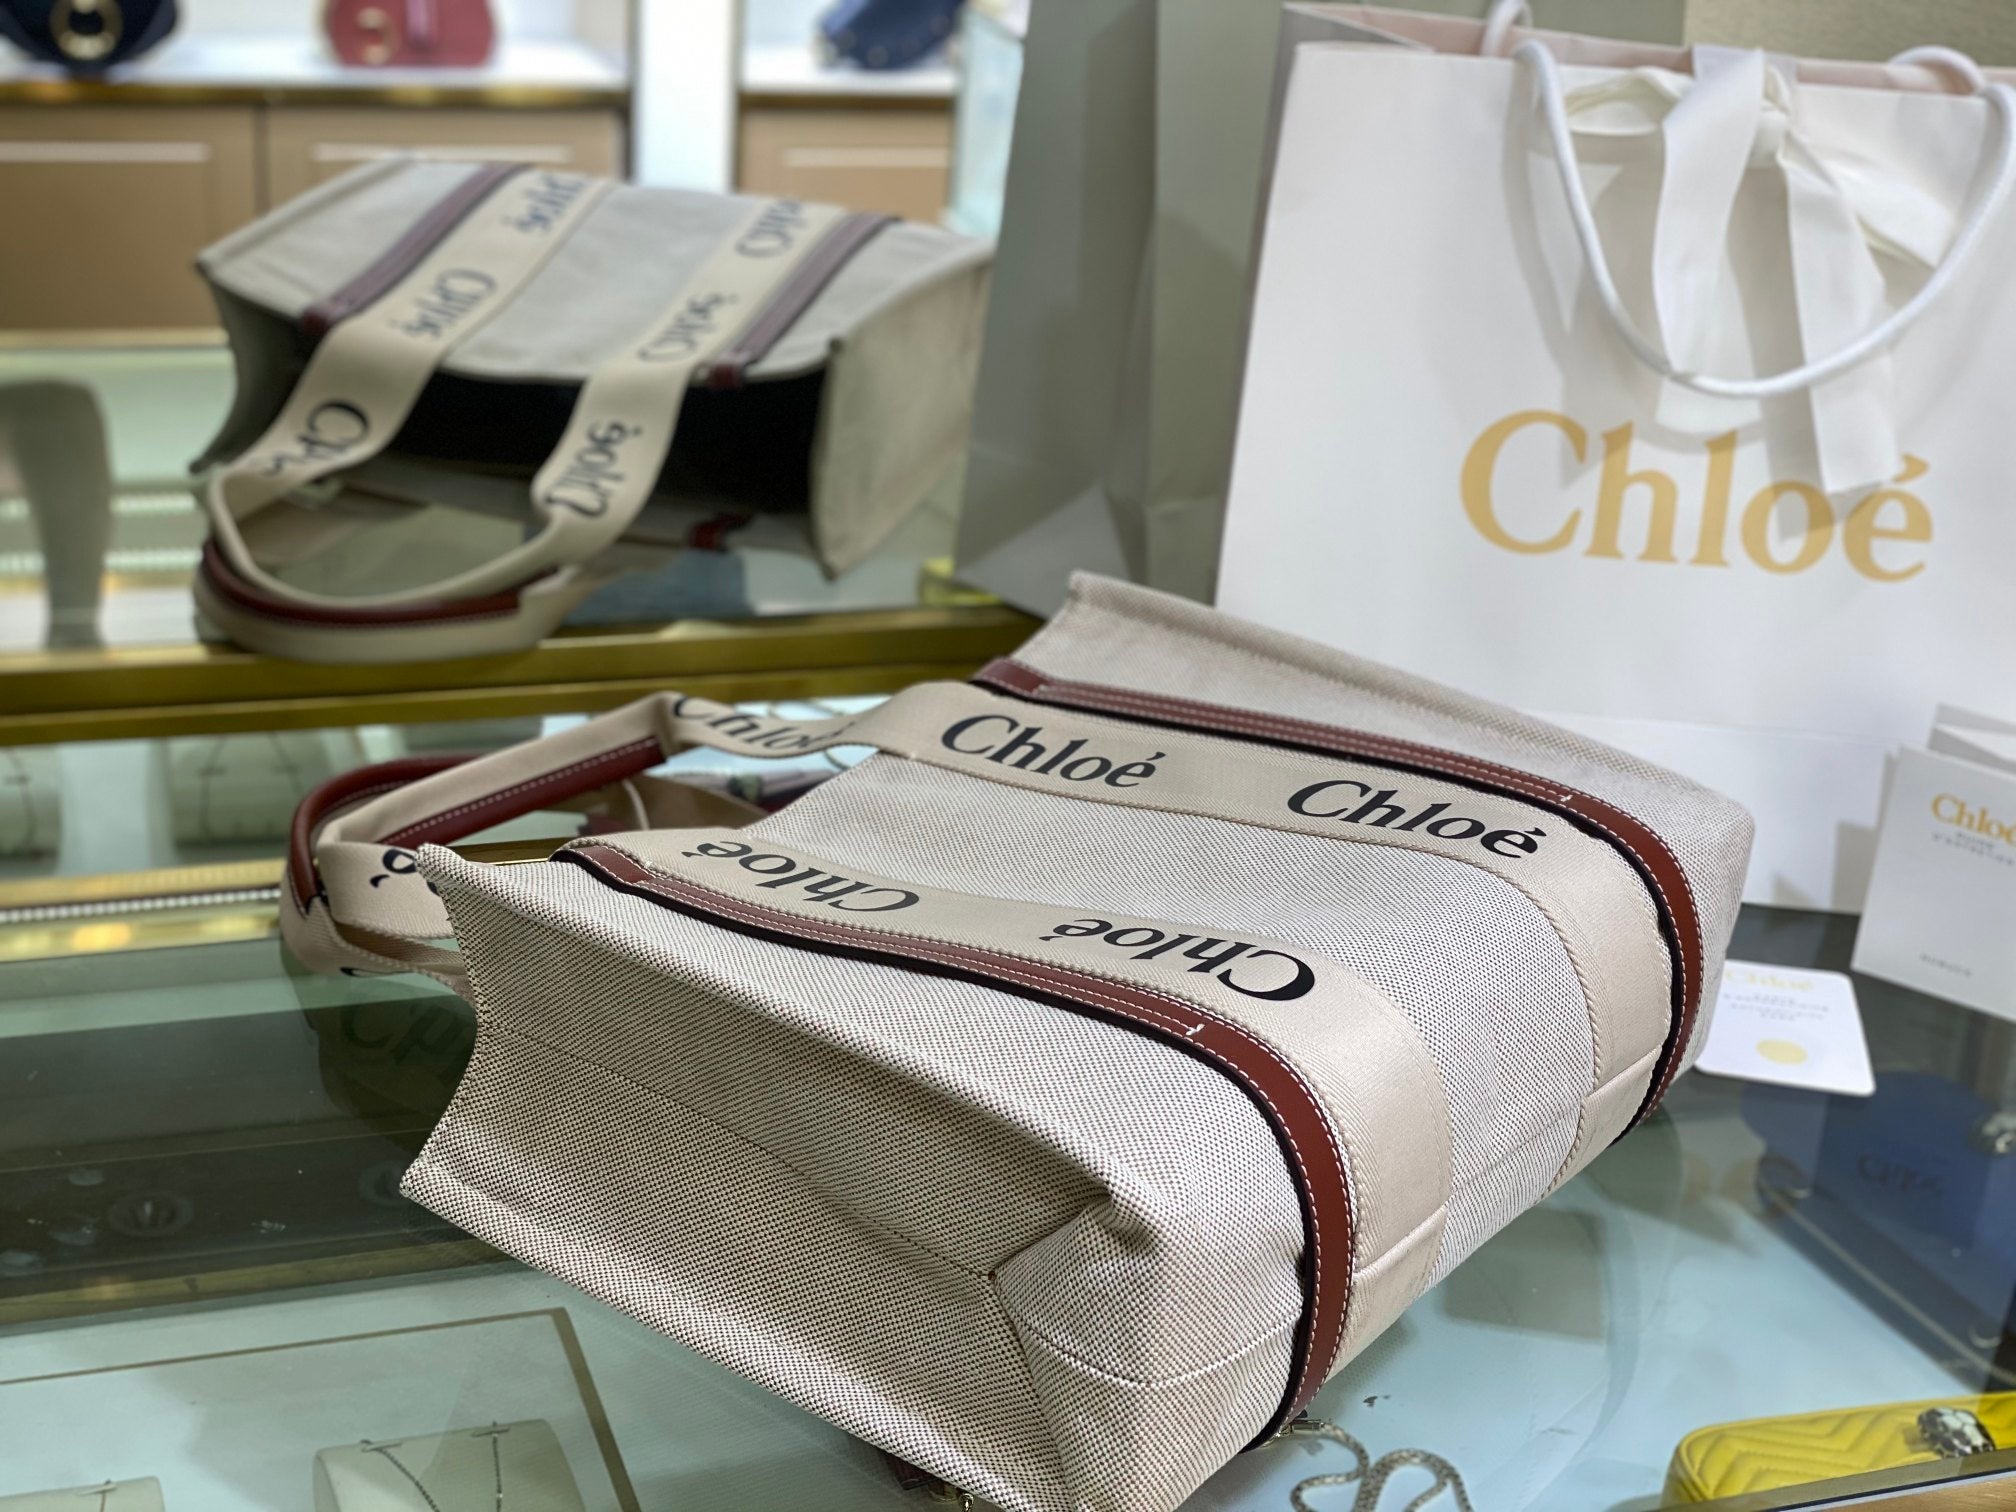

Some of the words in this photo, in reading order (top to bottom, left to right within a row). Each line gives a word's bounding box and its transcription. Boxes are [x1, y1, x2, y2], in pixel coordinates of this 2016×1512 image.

[1459, 409, 1933, 582] Chloé
[941, 714, 1167, 788] Chloé
[1287, 780, 1547, 858] Chloé
[681, 841, 920, 912] Chloé
[1038, 919, 1316, 1001] Chloé
